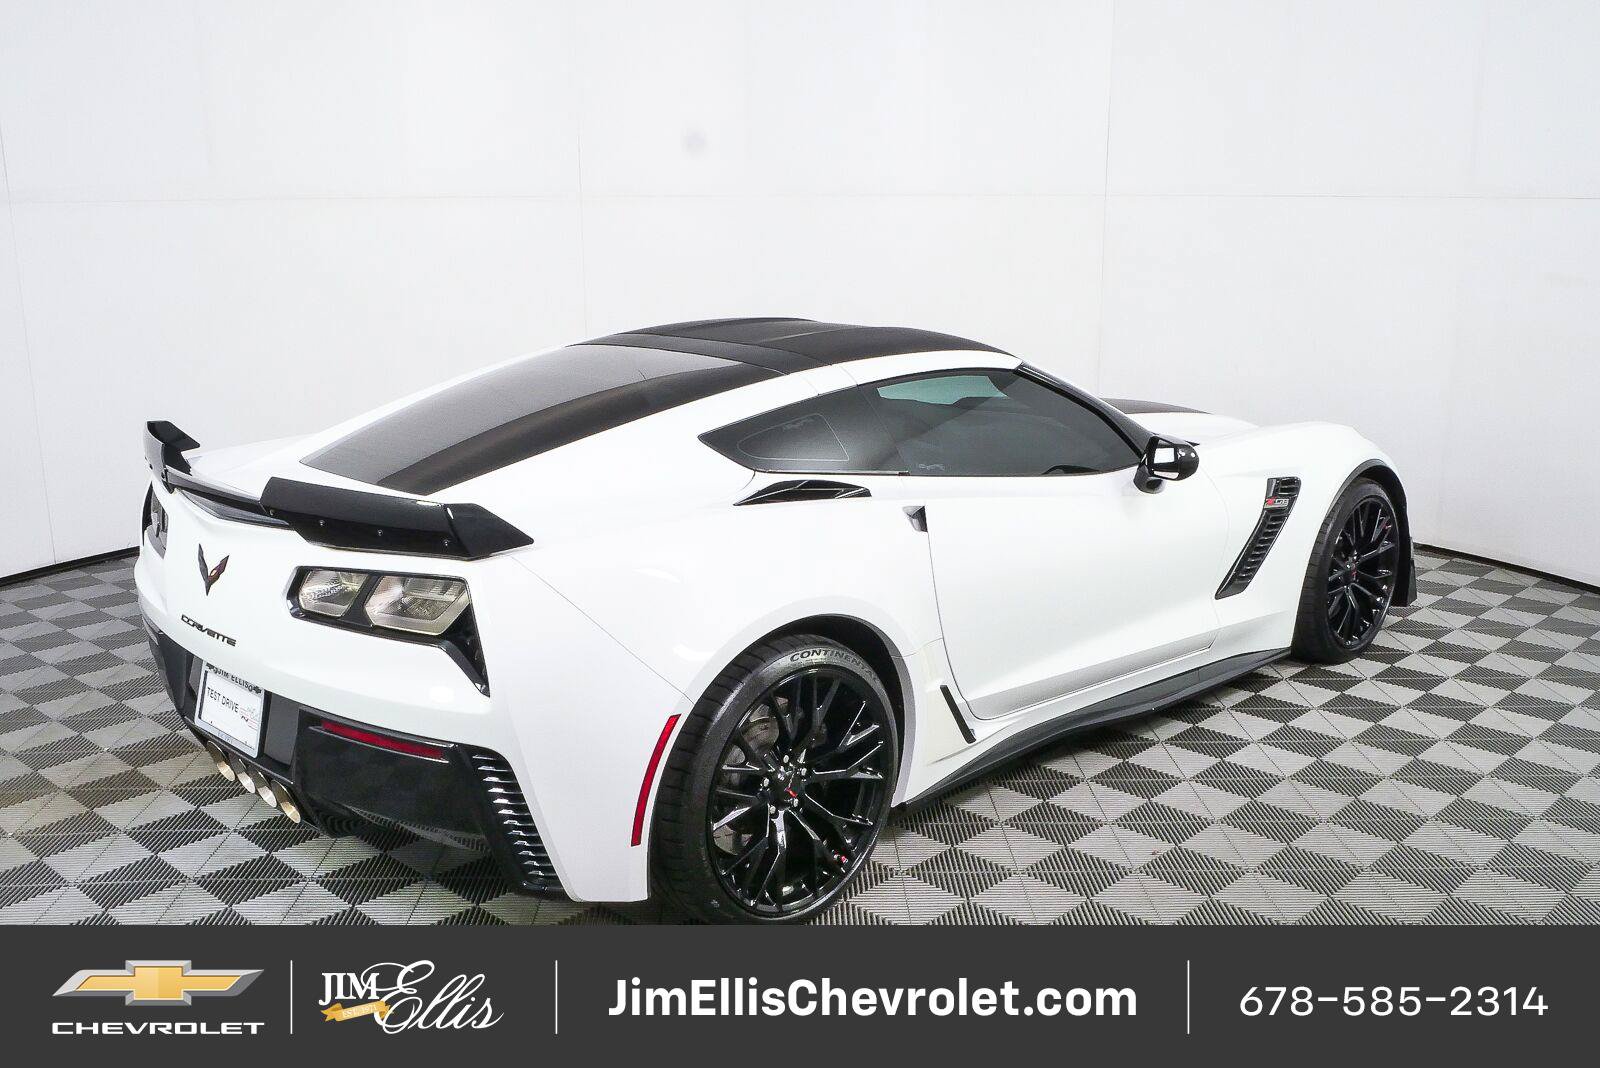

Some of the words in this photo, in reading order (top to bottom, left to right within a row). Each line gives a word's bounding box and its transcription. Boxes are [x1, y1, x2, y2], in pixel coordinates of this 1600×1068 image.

[181, 614, 237, 647] CORVETTE
[789, 648, 879, 684] CONTINENTAL
[207, 686, 221, 701] TEST
[222, 695, 239, 713] DRIVE
